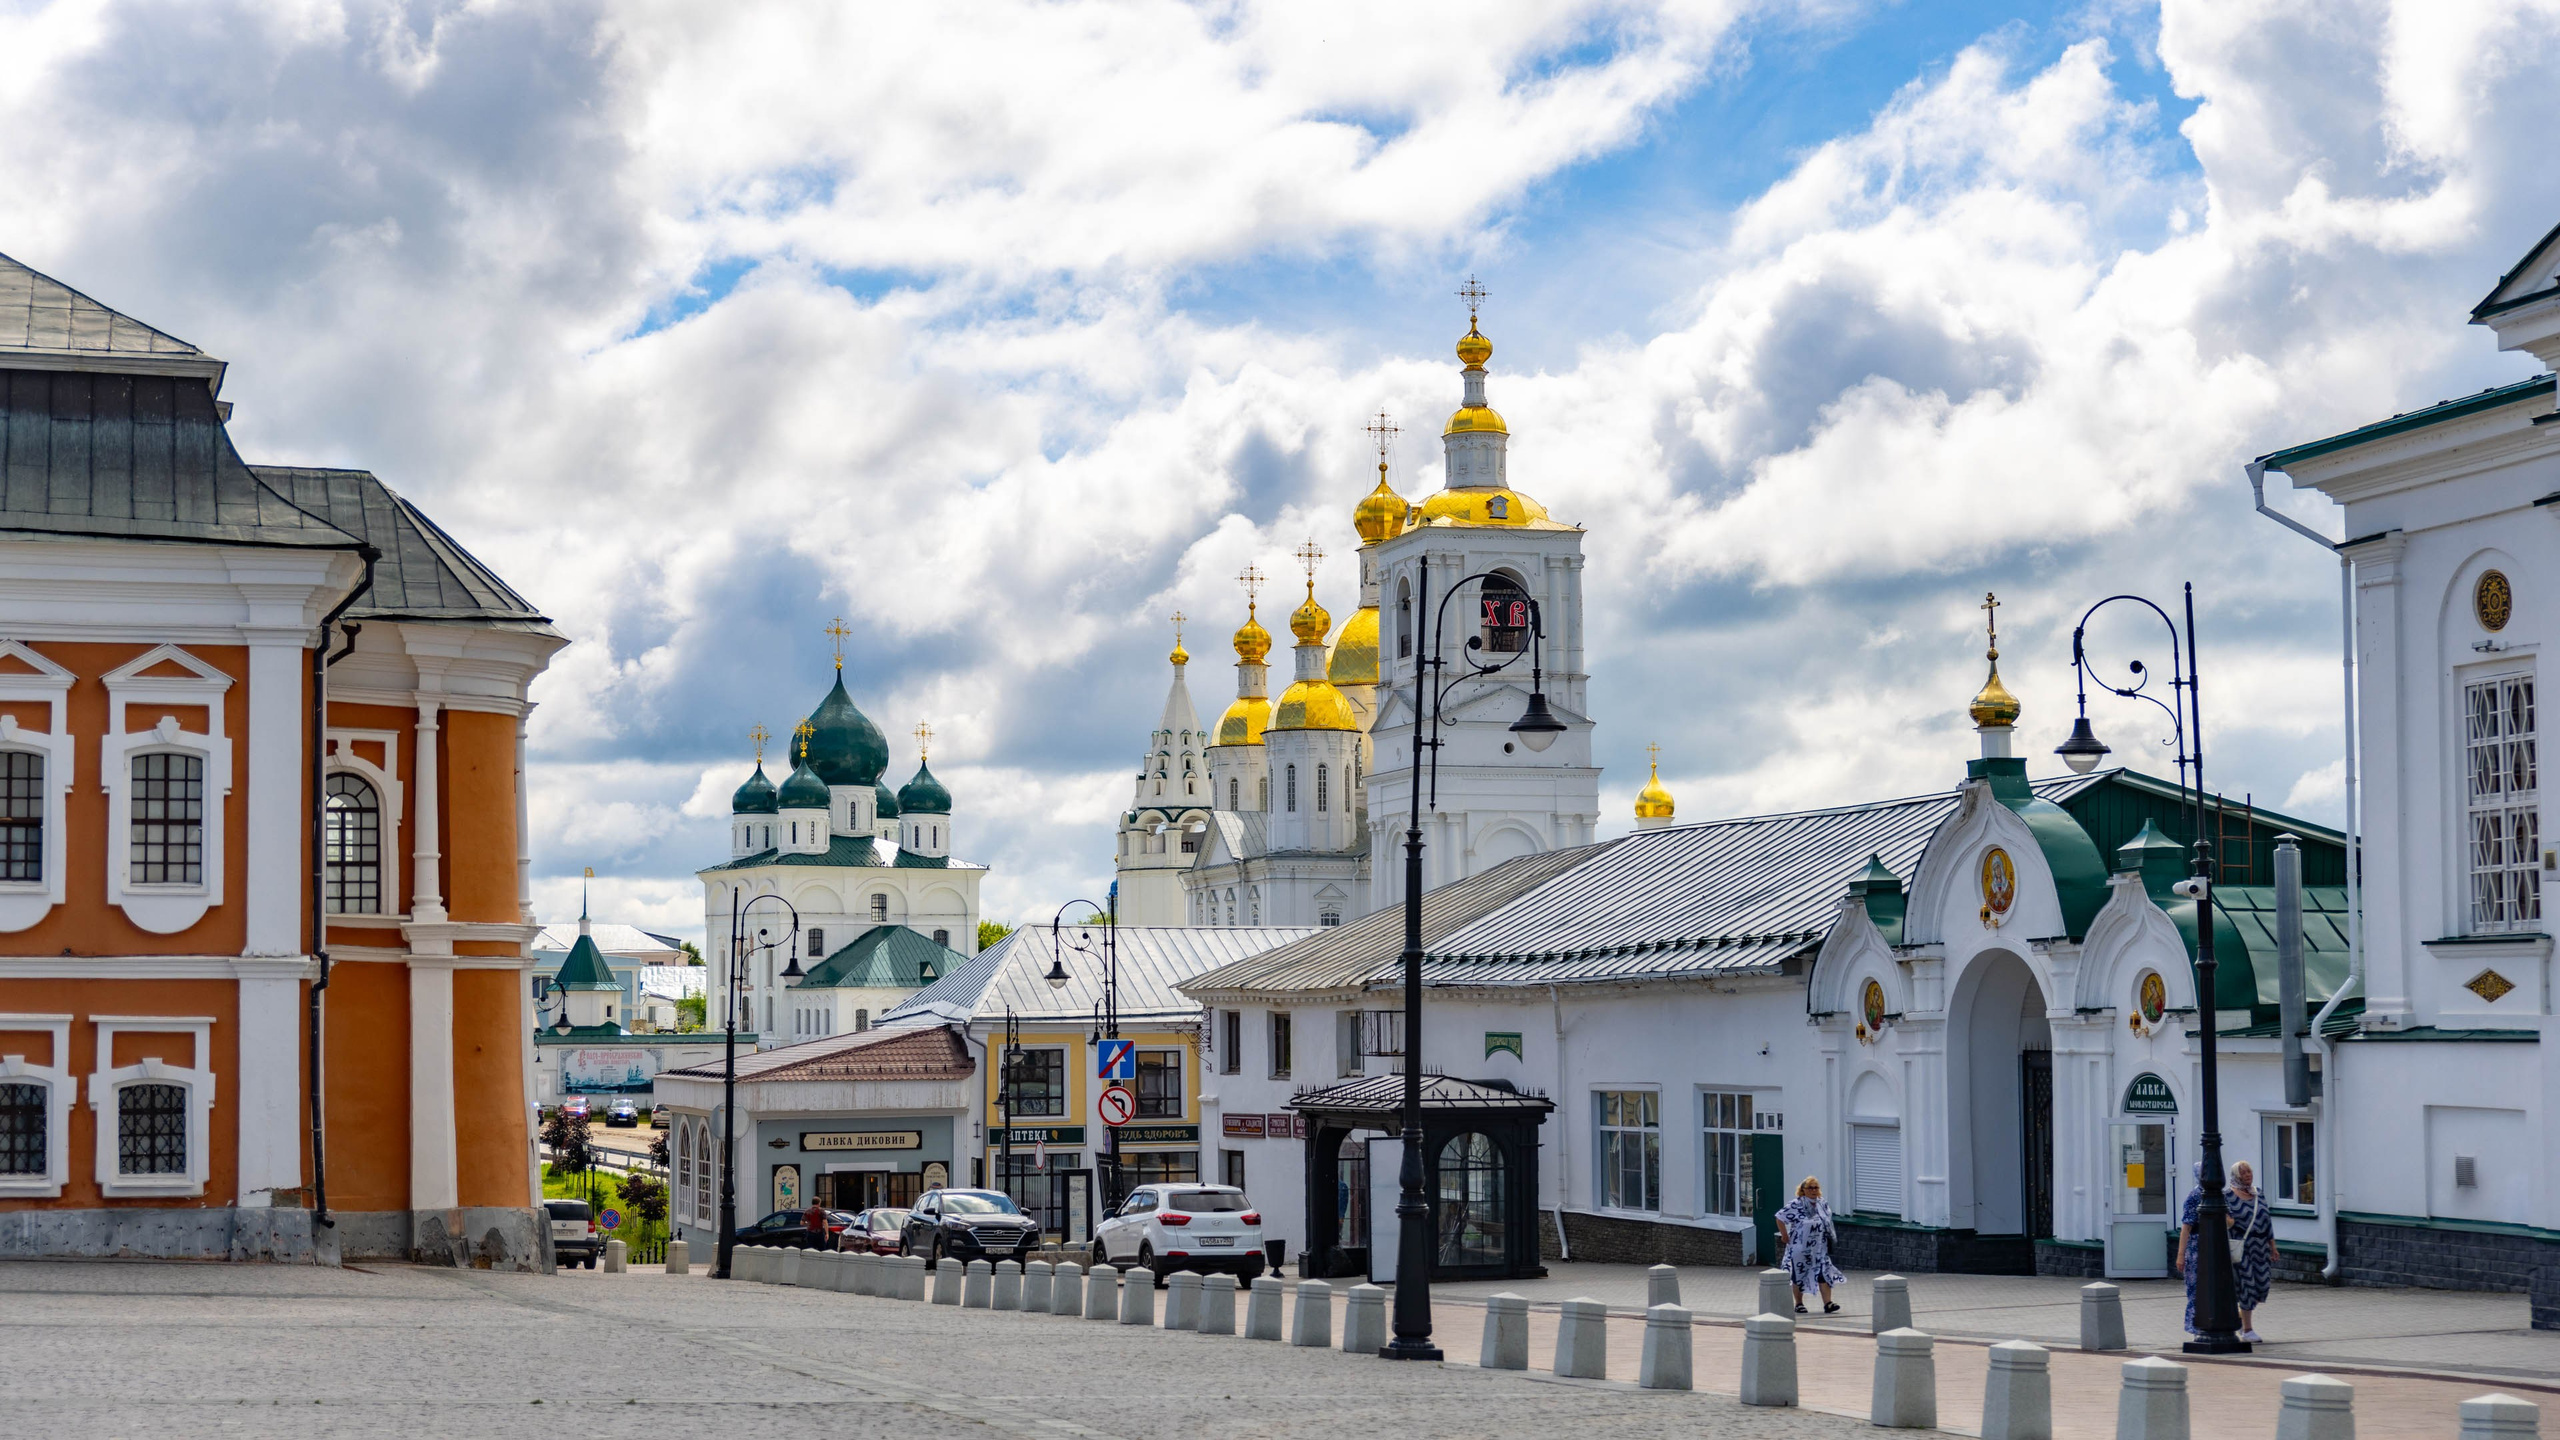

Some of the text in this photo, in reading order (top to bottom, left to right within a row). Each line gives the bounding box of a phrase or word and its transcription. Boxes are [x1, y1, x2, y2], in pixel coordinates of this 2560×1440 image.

[2136, 1083, 2166, 1096] ЛАВКА
[1144, 1129, 1189, 1140] ЗДОРОВЪ
[818, 1135, 906, 1147] ЛАВКА ДИКОВИН
